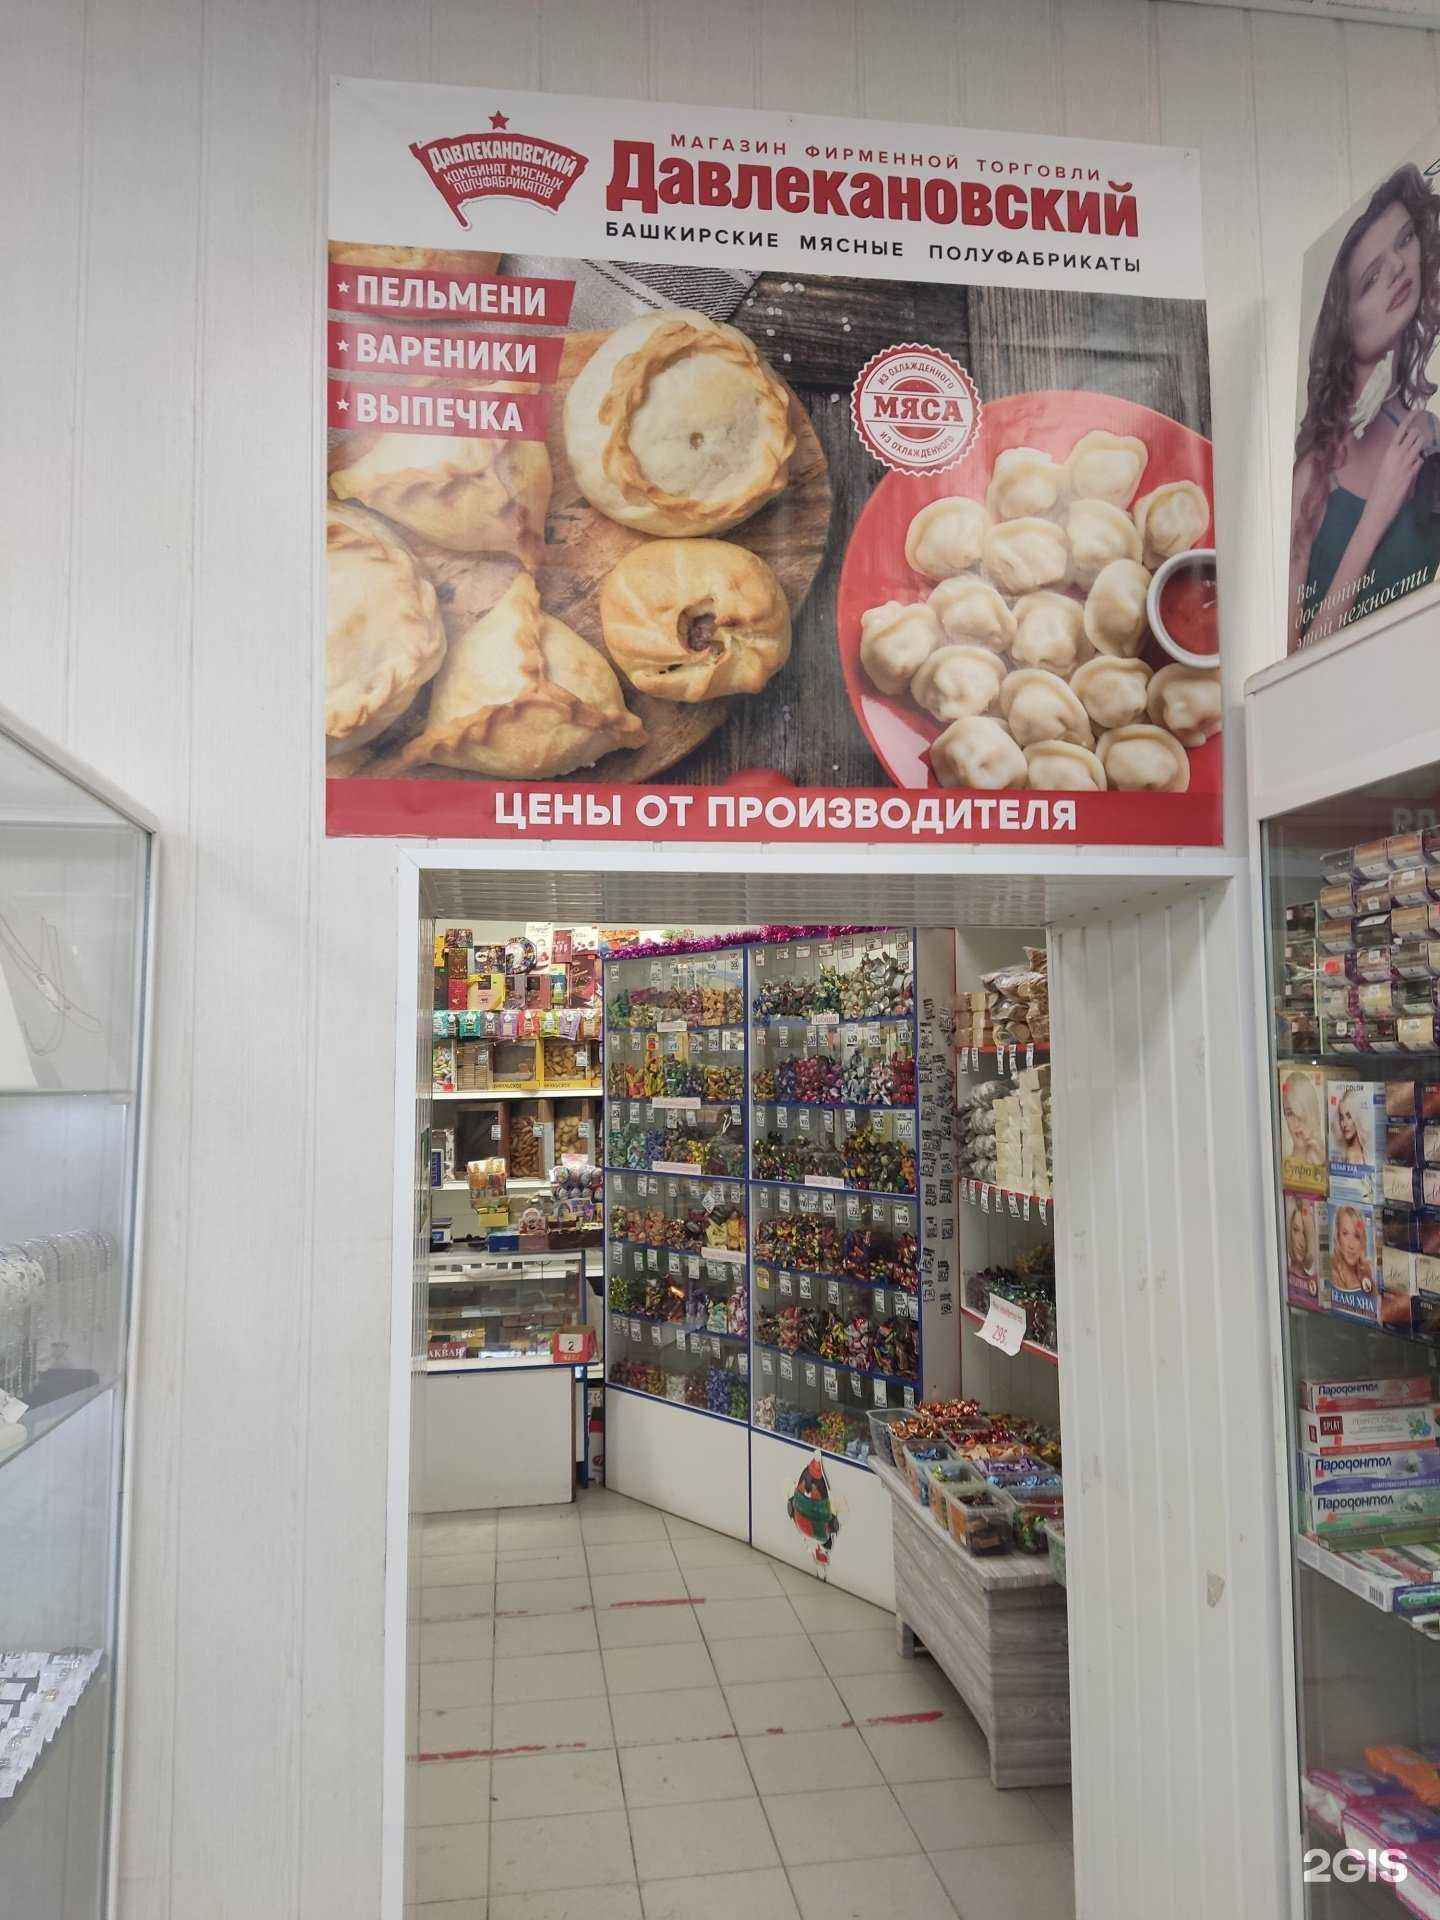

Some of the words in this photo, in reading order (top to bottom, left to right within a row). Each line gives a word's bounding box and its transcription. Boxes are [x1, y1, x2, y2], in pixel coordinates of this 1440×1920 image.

[427, 141, 578, 178] ДАВЛЕКАНОВСКИЙ
[670, 133, 787, 156] МАГАЗИН
[804, 145, 959, 170] ФИРМЕННОЙ
[976, 159, 1101, 181] ТОРГОВЛИ
[444, 163, 507, 185] КОМБИНАТ
[510, 164, 564, 191] МЯСНЫХ
[453, 175, 554, 199] ПОЛУФАБРИКАТОВ
[606, 139, 1139, 237] Давлекановский
[606, 221, 779, 248] БАШКИРСКИЕ
[800, 234, 904, 257] МЯСНЫЕ
[929, 244, 1141, 273] ПОЛУФАБРИКАТЫ
[356, 274, 546, 317] ПЕЛЬМЕНИ
[356, 333, 537, 374] ВАРЕНИКИ
[878, 373, 890, 386] ИЗ
[889, 361, 955, 390] ОХЛАЖДЕННОГО
[356, 392, 524, 432] ВЫПЕЧКА
[873, 395, 964, 422] МЯСА
[880, 431, 893, 443] ИЗ
[891, 434, 955, 459] ОХЛАЖДЕННОГО
[1294, 568, 1377, 630] достойны
[1296, 579, 1318, 604] Вы
[1337, 565, 1430, 629] нежности
[495, 791, 622, 830] ЦЕНЫ
[635, 794, 694, 827] ОТ
[707, 796, 1077, 835] ПРОИЗВОДИТЕЛЯ
[1318, 1383, 1379, 1396] Пародонтол
[1315, 1456, 1393, 1472] Пародонтол
[1317, 1494, 1394, 1512] Пародонтол
